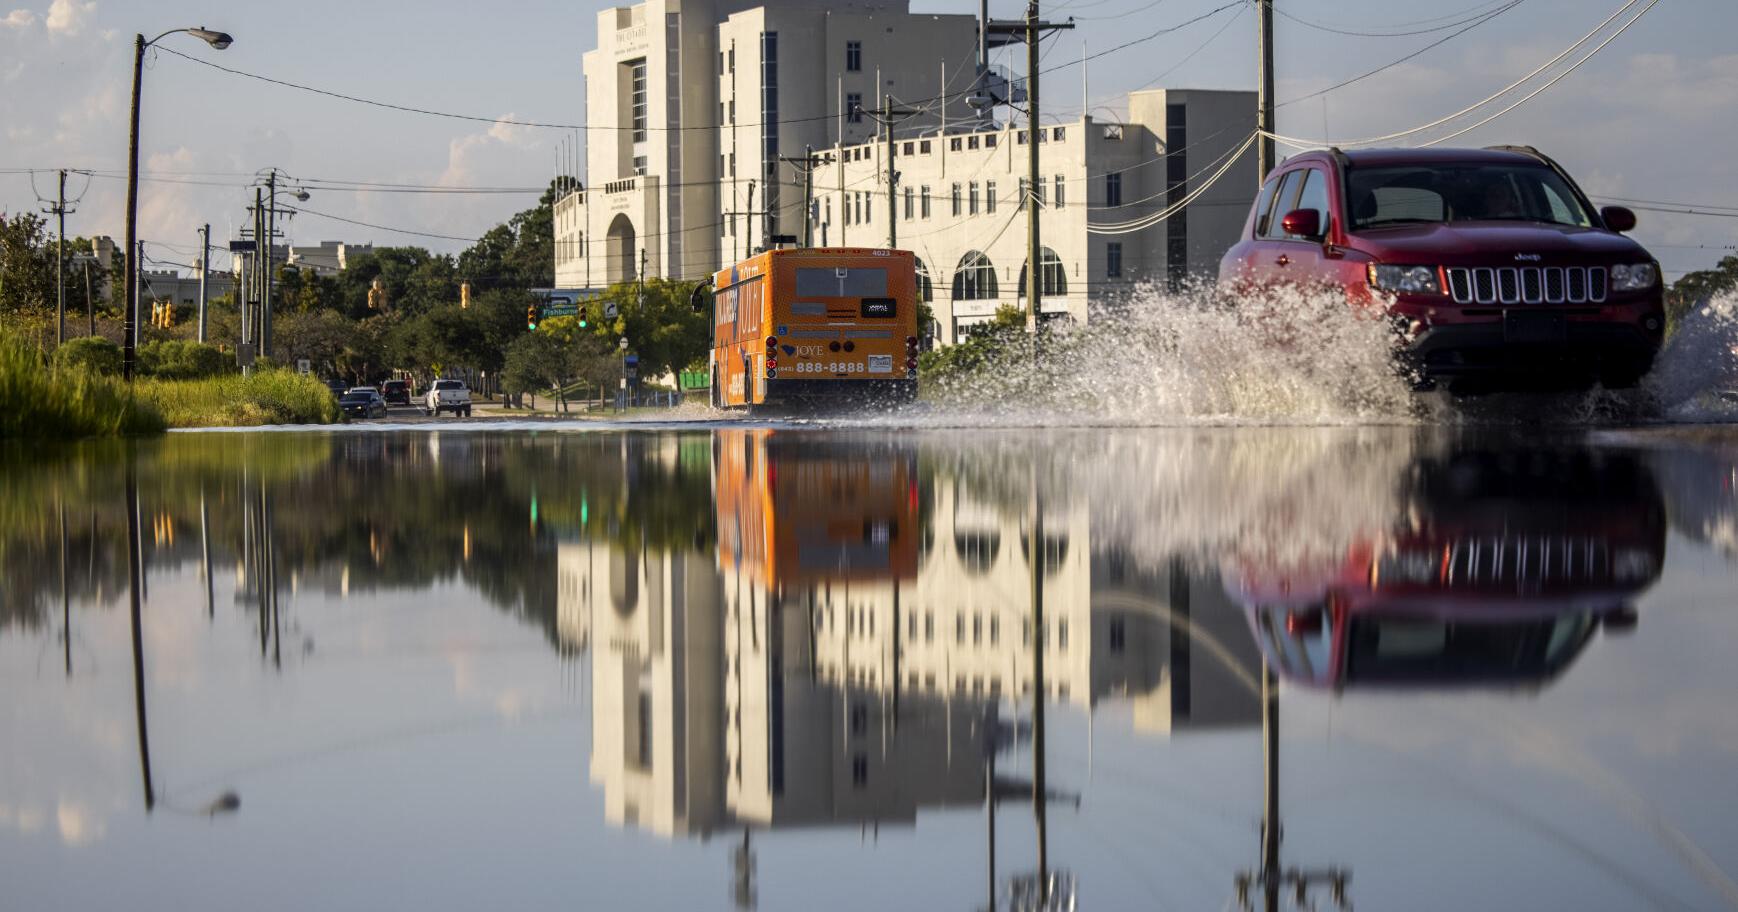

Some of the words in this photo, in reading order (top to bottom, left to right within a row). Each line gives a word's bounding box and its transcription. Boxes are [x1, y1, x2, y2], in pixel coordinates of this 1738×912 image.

[1514, 253, 1541, 262] Jeep
[796, 345, 824, 357] JOYE
[796, 362, 864, 373] 888-8888
